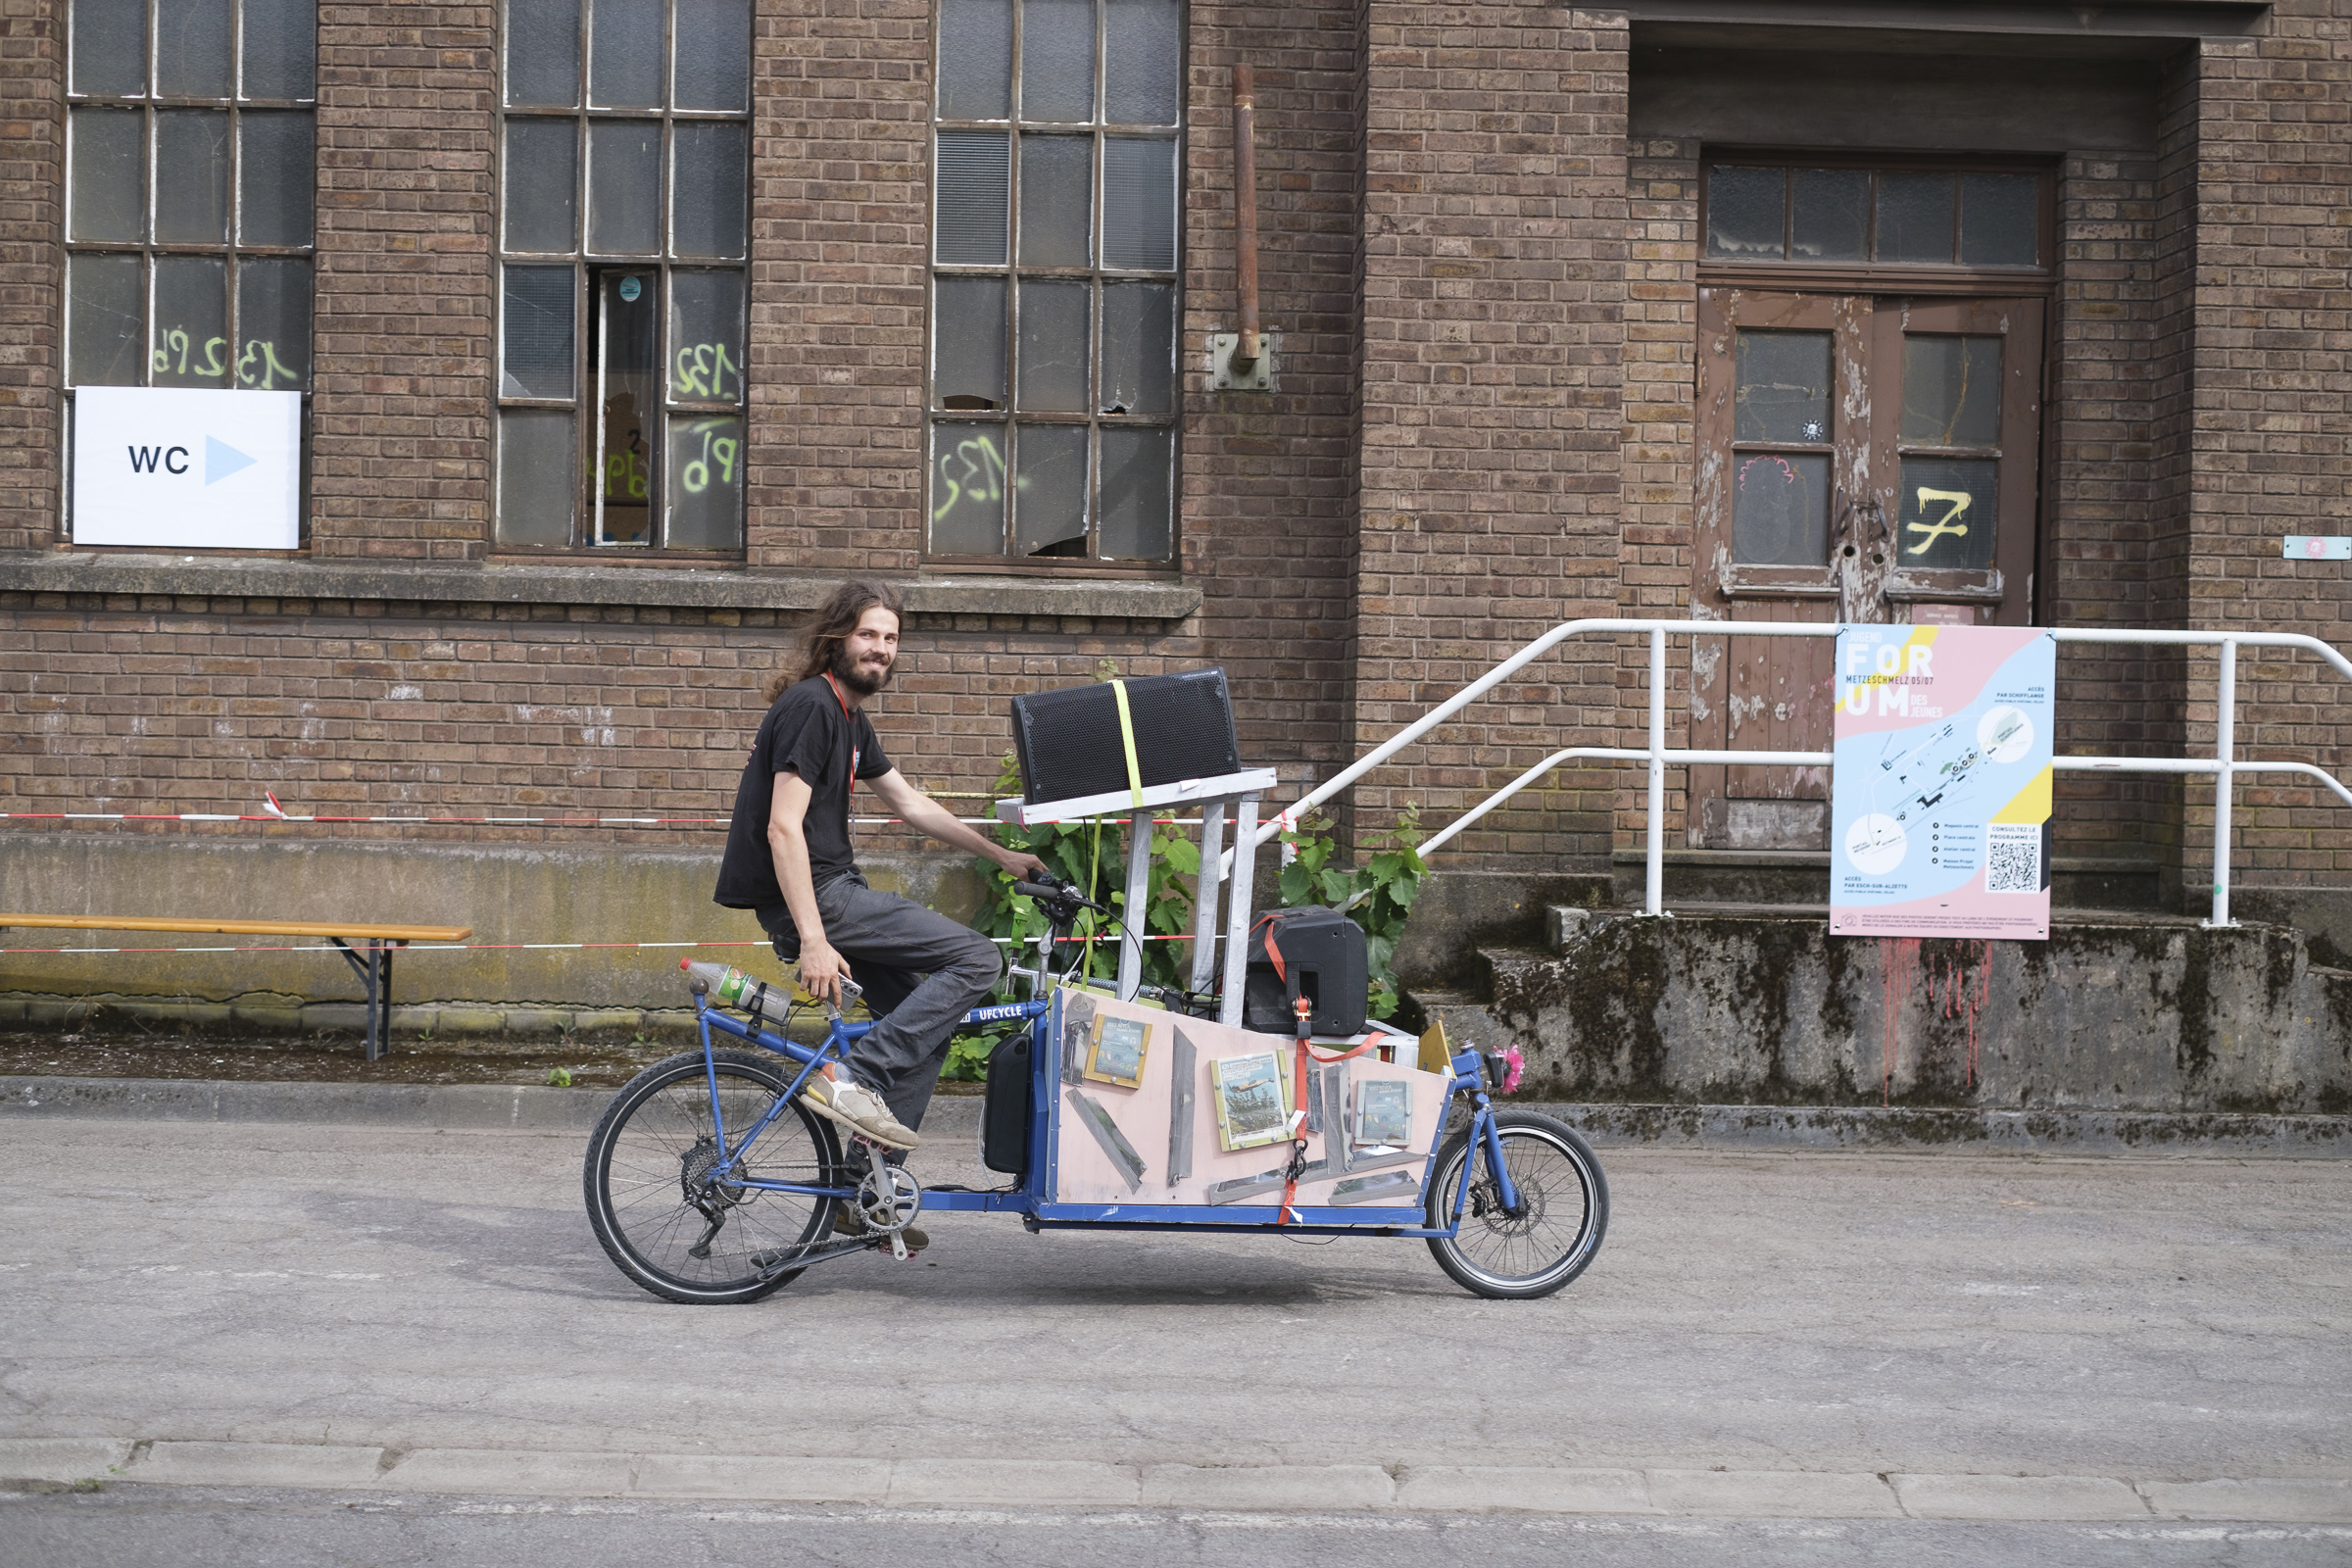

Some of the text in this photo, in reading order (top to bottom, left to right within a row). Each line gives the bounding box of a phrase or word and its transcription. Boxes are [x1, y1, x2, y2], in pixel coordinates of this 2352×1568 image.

[127, 445, 190, 475] WC
[1848, 631, 1882, 644] JUGEND
[1846, 643, 1934, 678] FOR
[1845, 675, 1935, 685] METZESCHMELZ 05/07
[1845, 683, 1909, 716] UM
[1911, 694, 1928, 706] DES
[1910, 707, 1942, 718] JEUNES
[979, 1005, 1022, 1020] UPCYCLE
